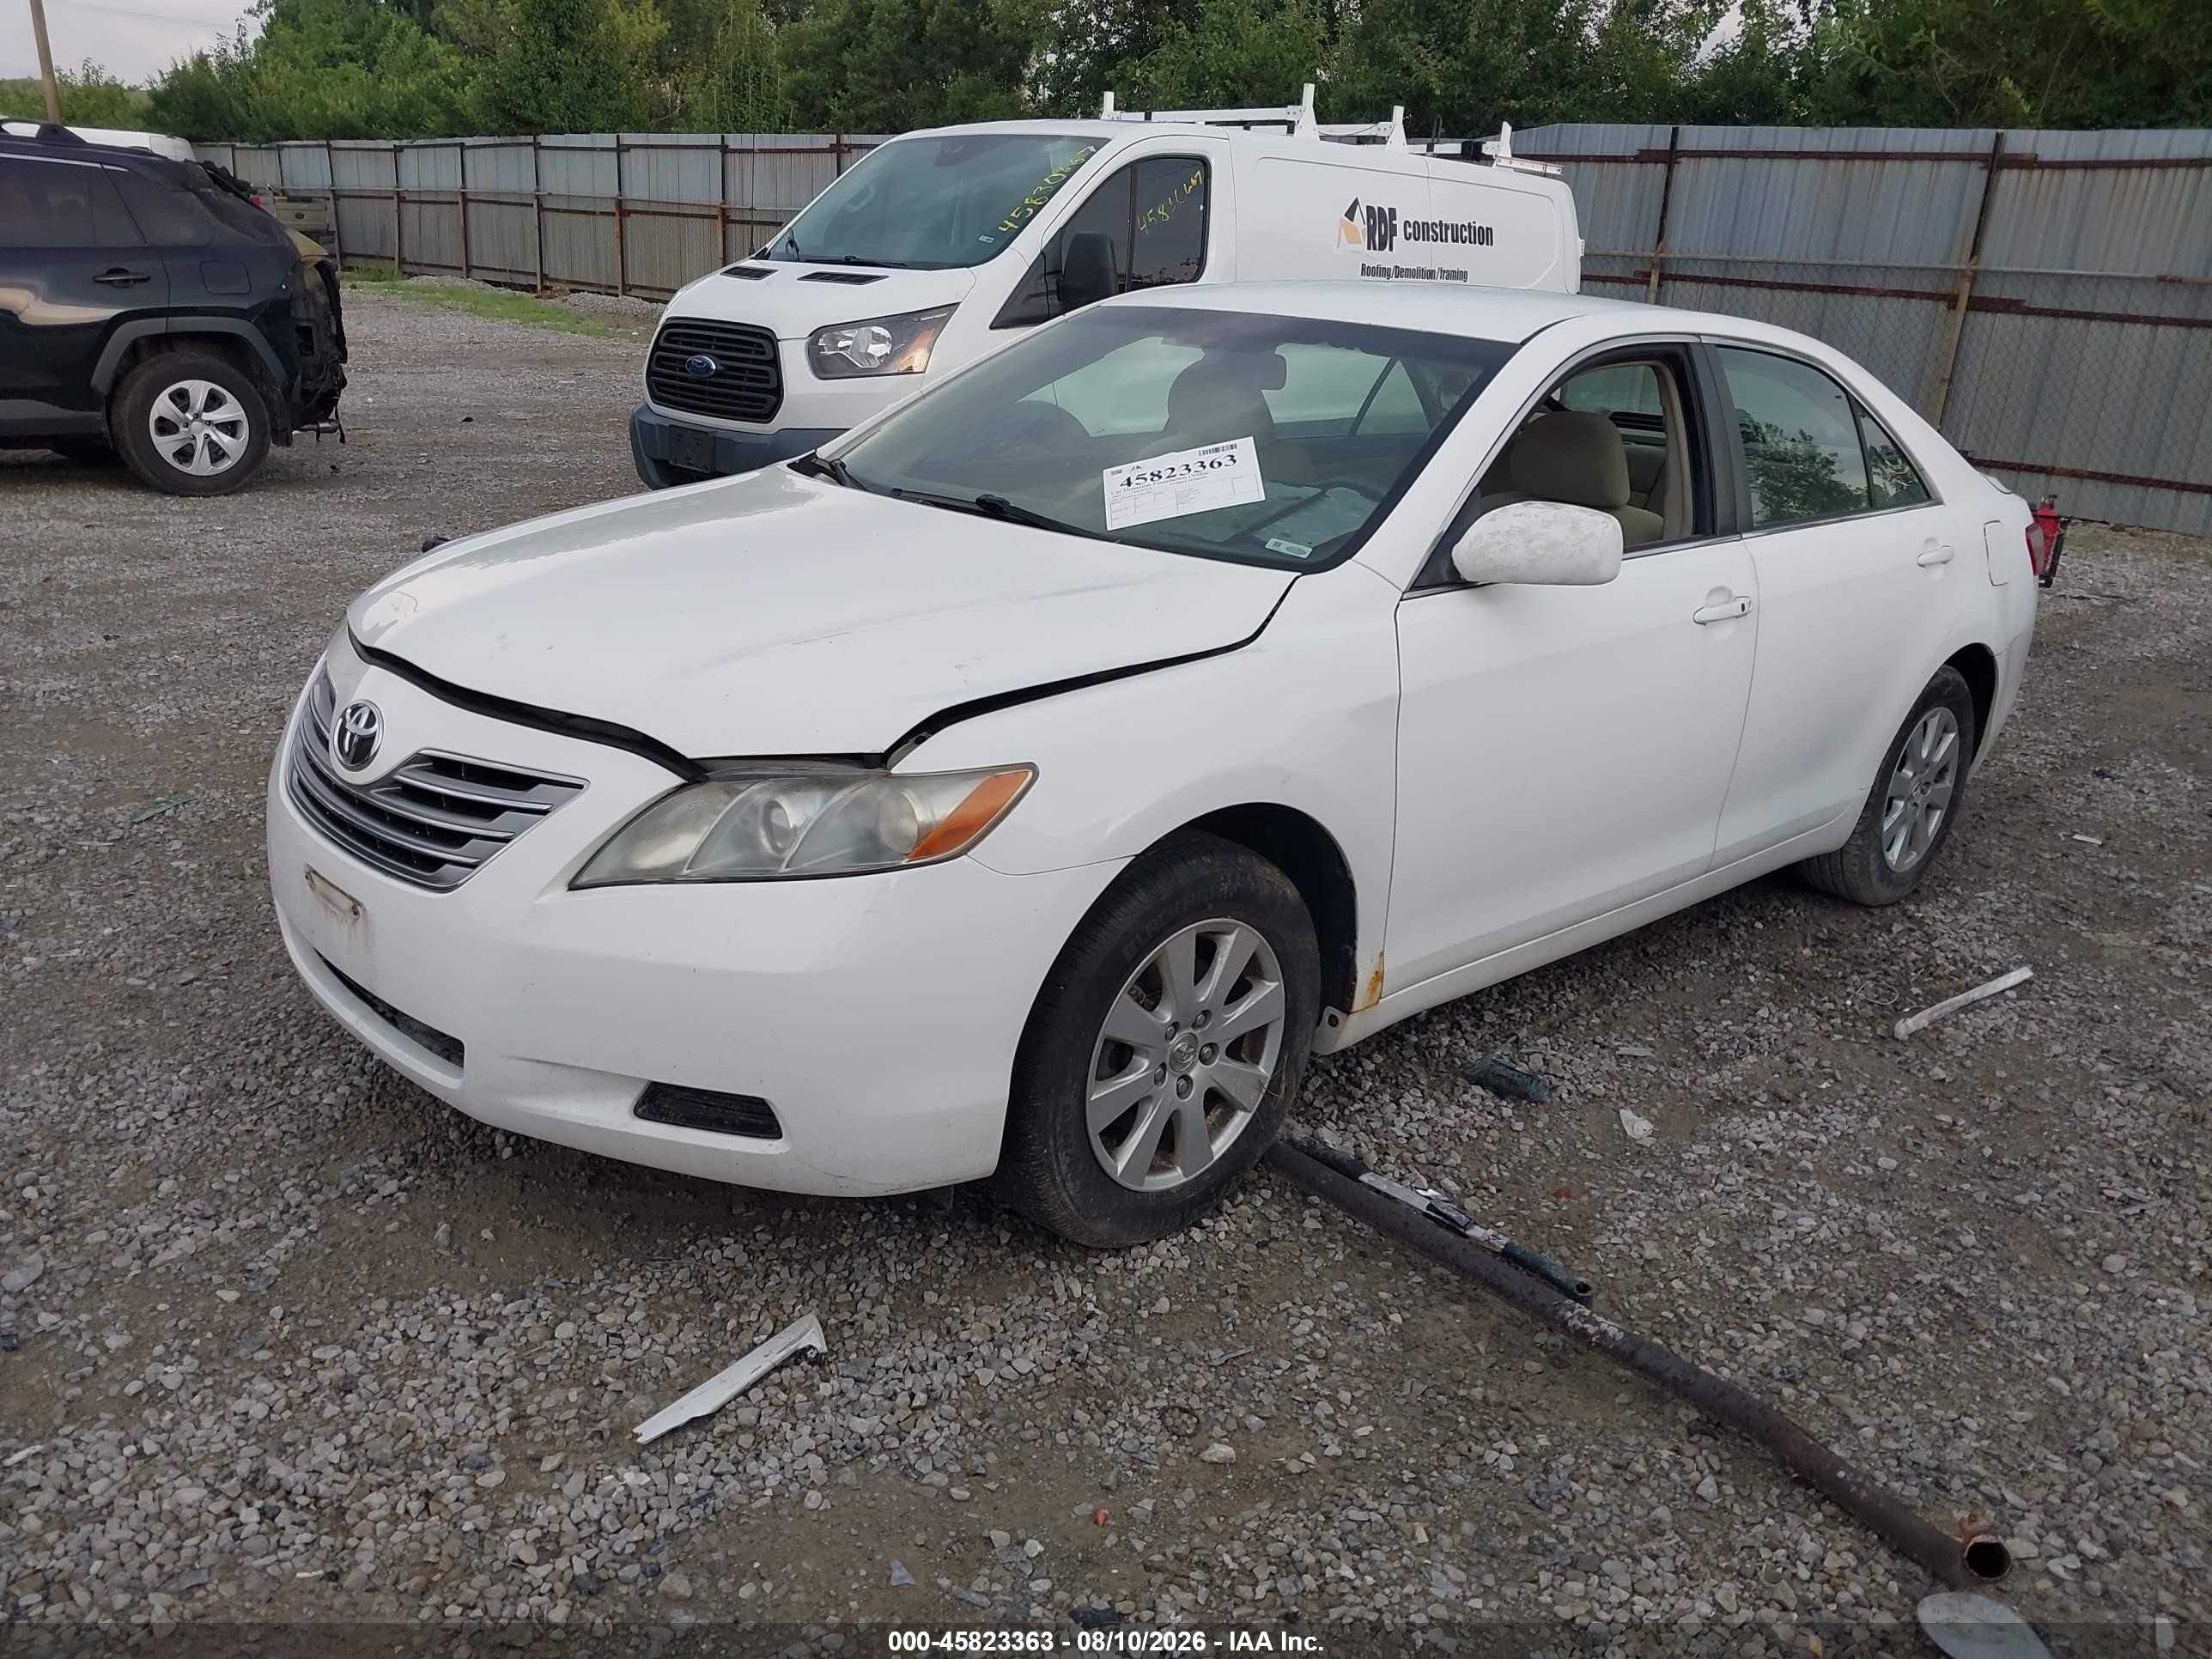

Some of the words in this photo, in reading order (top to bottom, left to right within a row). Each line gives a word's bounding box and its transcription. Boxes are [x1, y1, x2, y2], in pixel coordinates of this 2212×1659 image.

[1364, 204, 1398, 252] RDF
[1402, 218, 1494, 247] construction
[1120, 454, 1237, 488] 45823363
